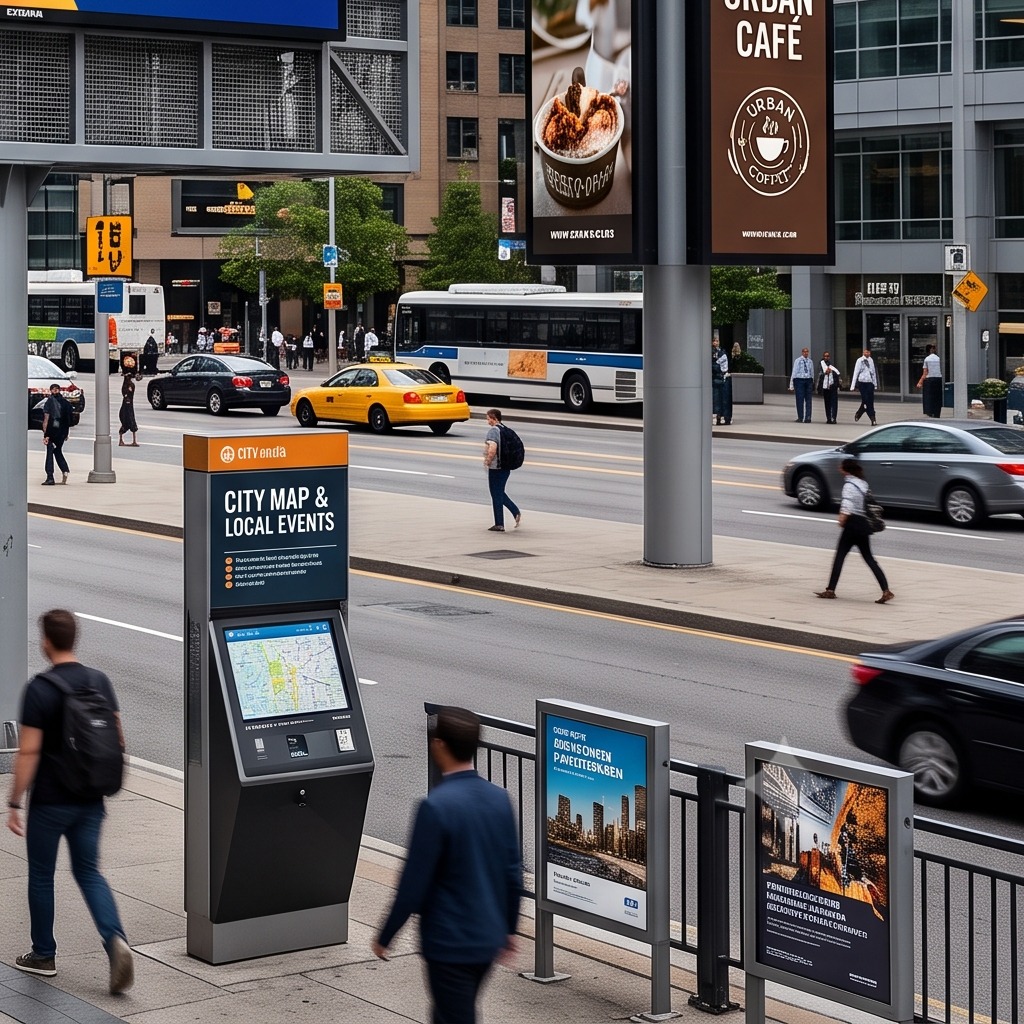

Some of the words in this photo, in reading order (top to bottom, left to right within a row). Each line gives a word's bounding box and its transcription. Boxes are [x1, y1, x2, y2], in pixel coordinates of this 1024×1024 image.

[736, 14, 803, 61] CAFÉ
[746, 97, 796, 123] URBAN
[237, 447, 258, 460] CITY
[224, 488, 266, 514] CITY
[270, 486, 310, 511] MAP
[314, 485, 329, 508] &
[225, 516, 274, 538] LOCAL
[278, 511, 335, 535] EVENTS
